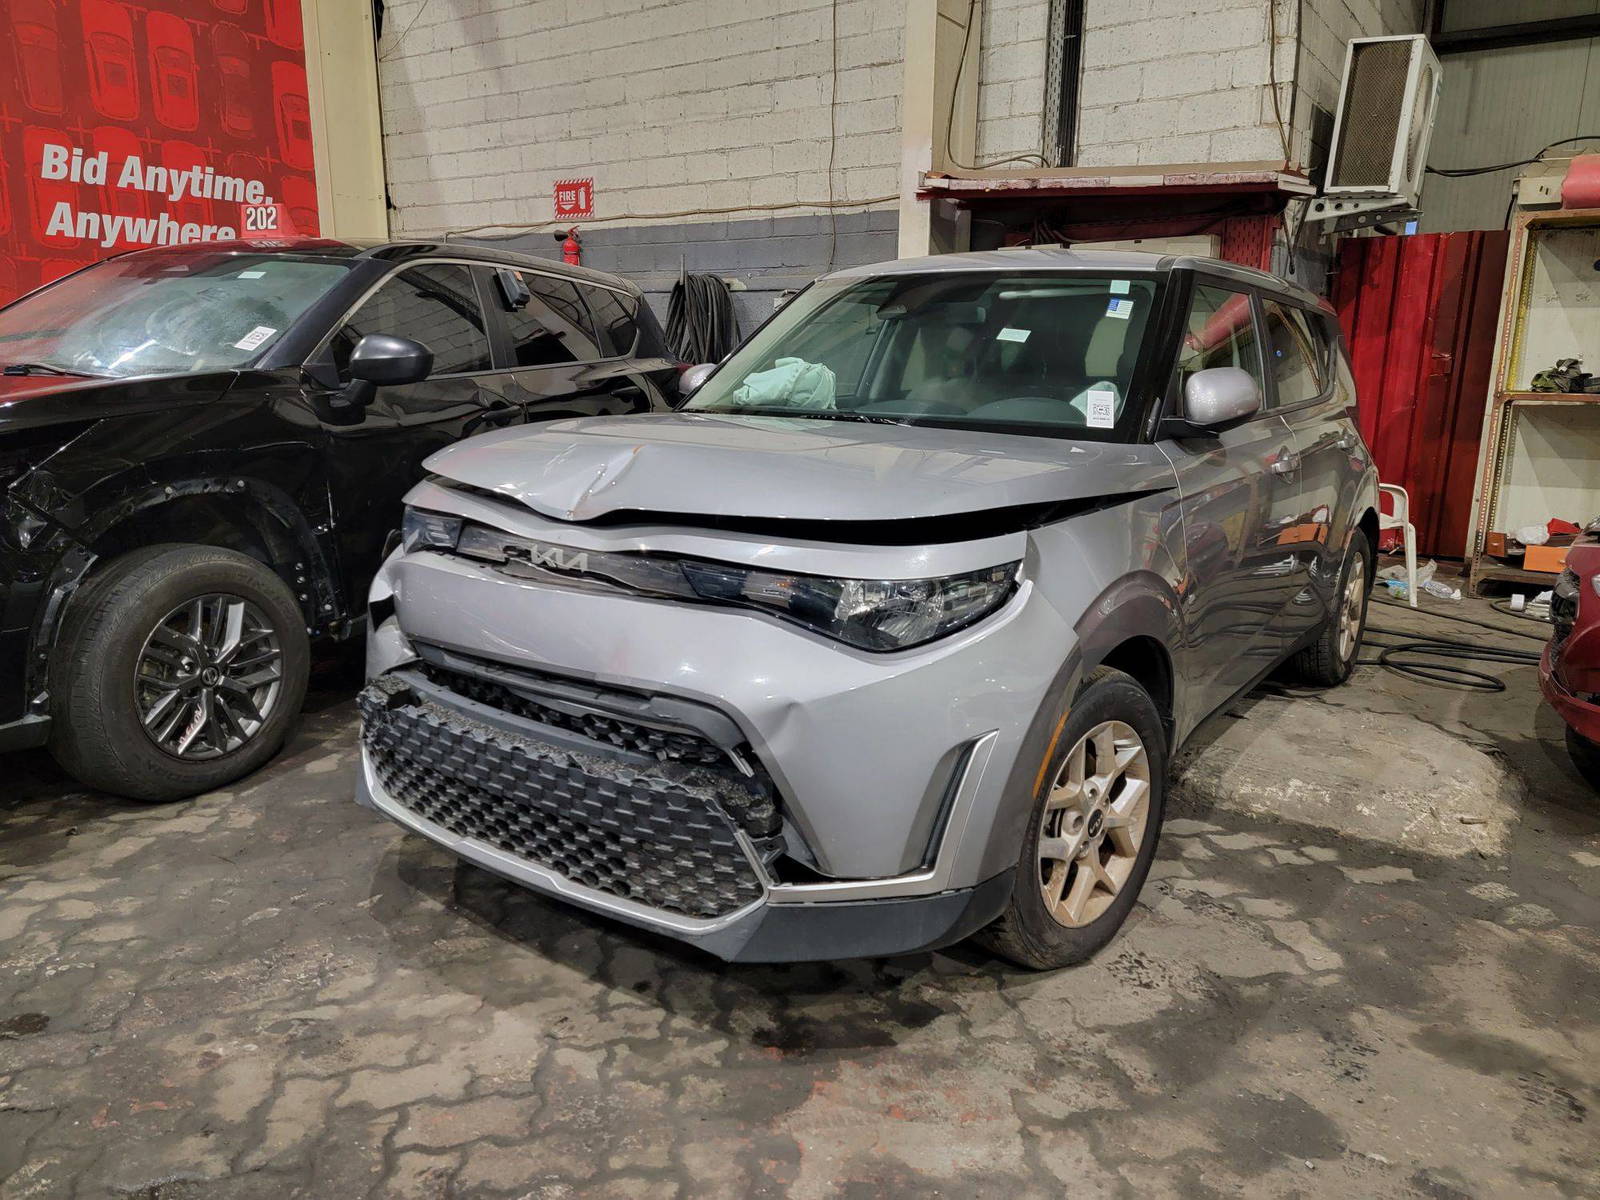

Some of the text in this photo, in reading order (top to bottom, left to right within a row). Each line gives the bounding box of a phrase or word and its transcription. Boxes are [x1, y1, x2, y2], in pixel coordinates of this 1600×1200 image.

[41, 143, 108, 186] Bid
[559, 190, 576, 201] FIRE
[246, 206, 277, 230] 202
[531, 543, 588, 570] KIA
